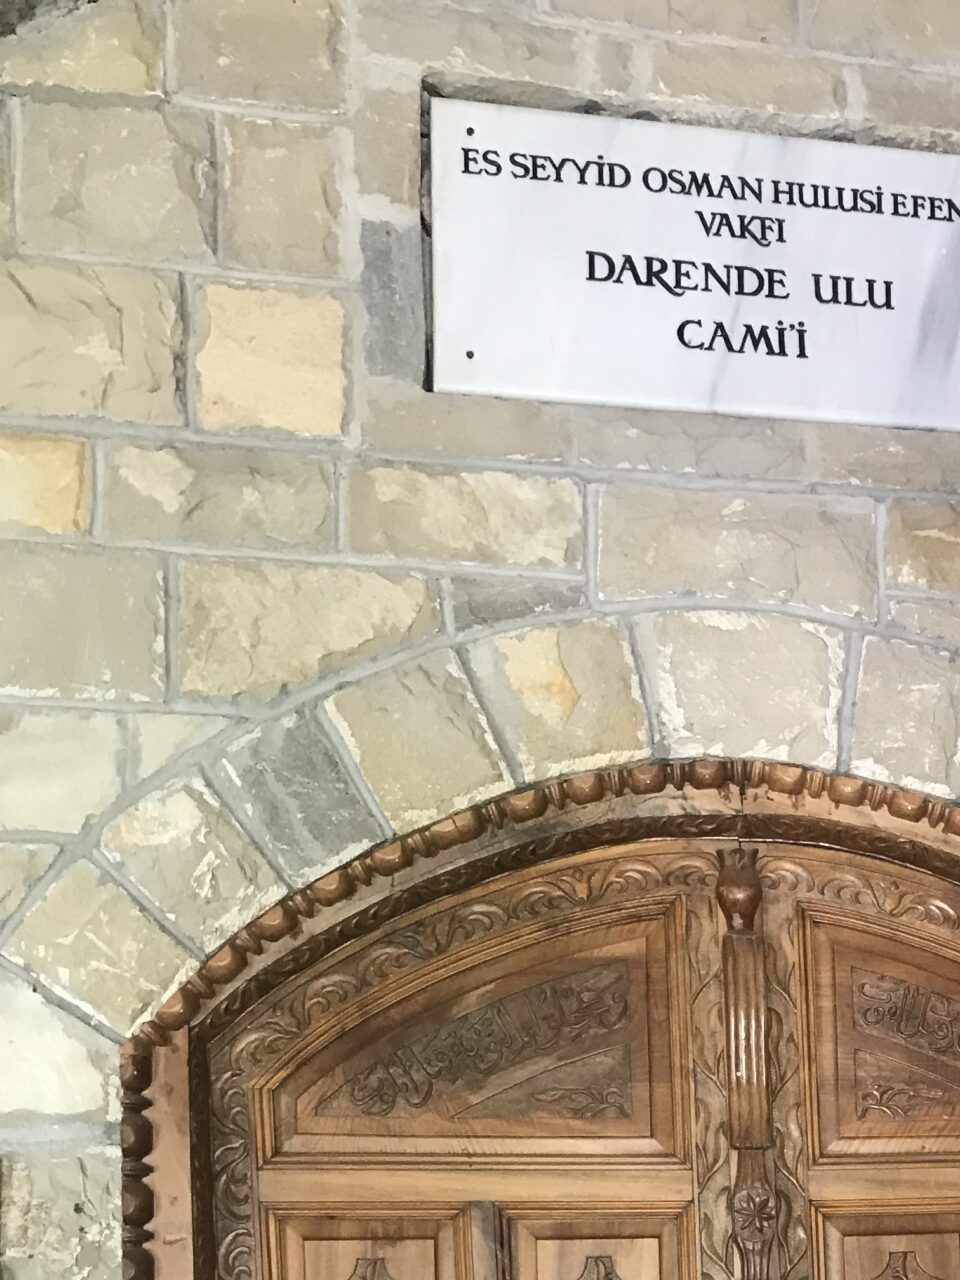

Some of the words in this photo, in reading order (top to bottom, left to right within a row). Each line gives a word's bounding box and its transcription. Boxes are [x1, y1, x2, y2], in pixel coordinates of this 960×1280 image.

[461, 147, 502, 177] ES
[510, 153, 631, 189] SEYYİD
[642, 167, 763, 204] OSMAN
[771, 181, 884, 214] HULUSİ
[694, 210, 786, 247] VAKFI
[585, 251, 790, 299] DARENDE
[812, 273, 894, 310] ULU
